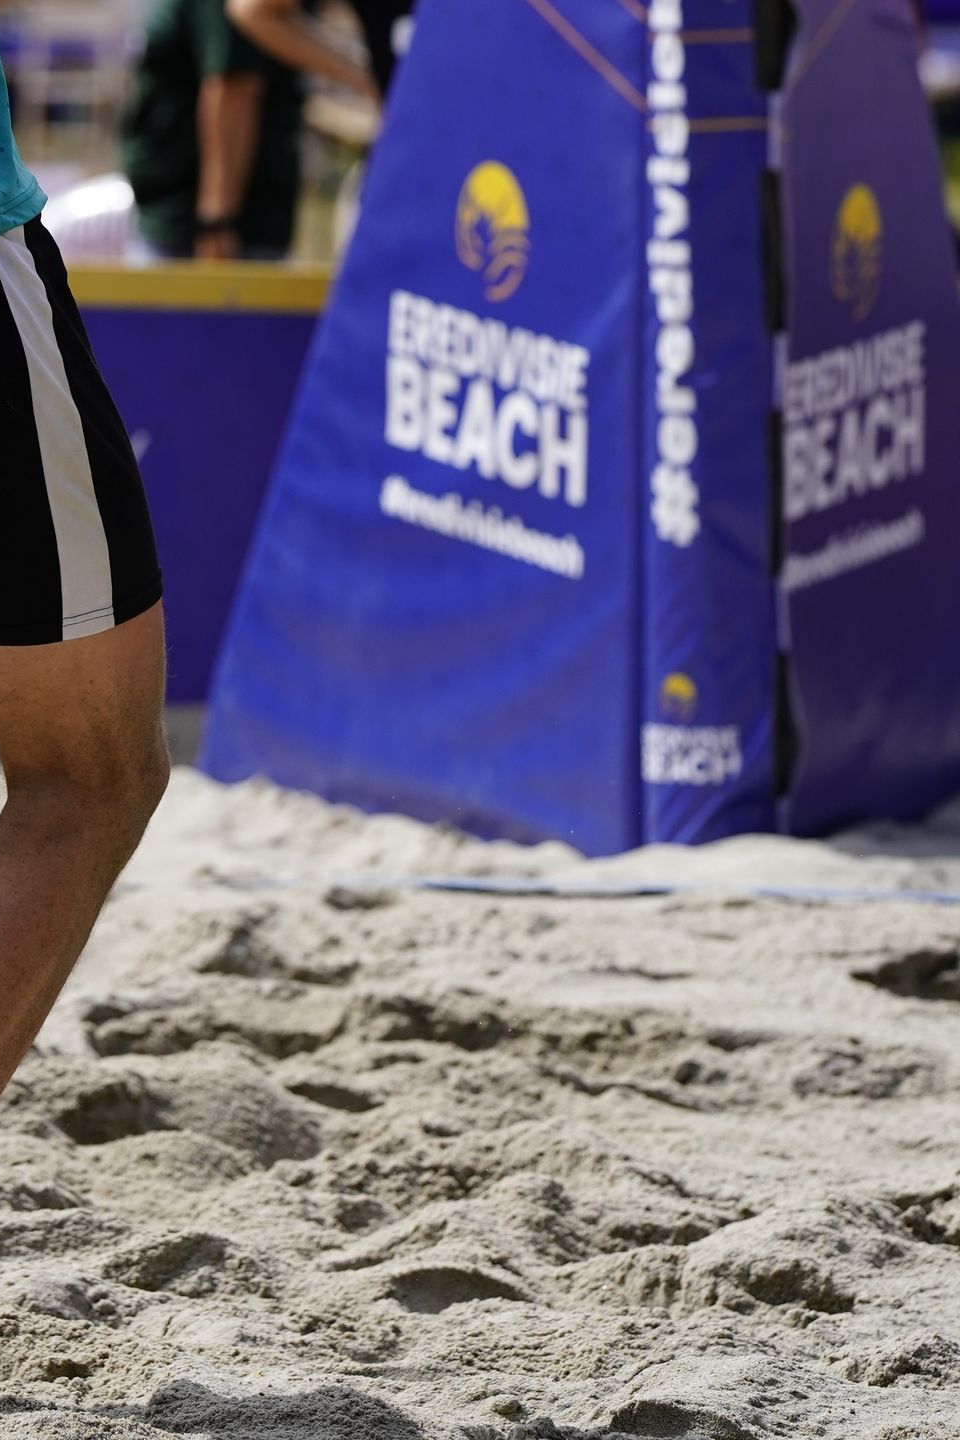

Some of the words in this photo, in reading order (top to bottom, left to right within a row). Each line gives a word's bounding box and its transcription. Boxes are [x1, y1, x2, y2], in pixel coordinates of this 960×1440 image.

[388, 289, 589, 413] EREDIVISIE
[385, 355, 588, 506] BEACH
[784, 387, 925, 521] BEACH
